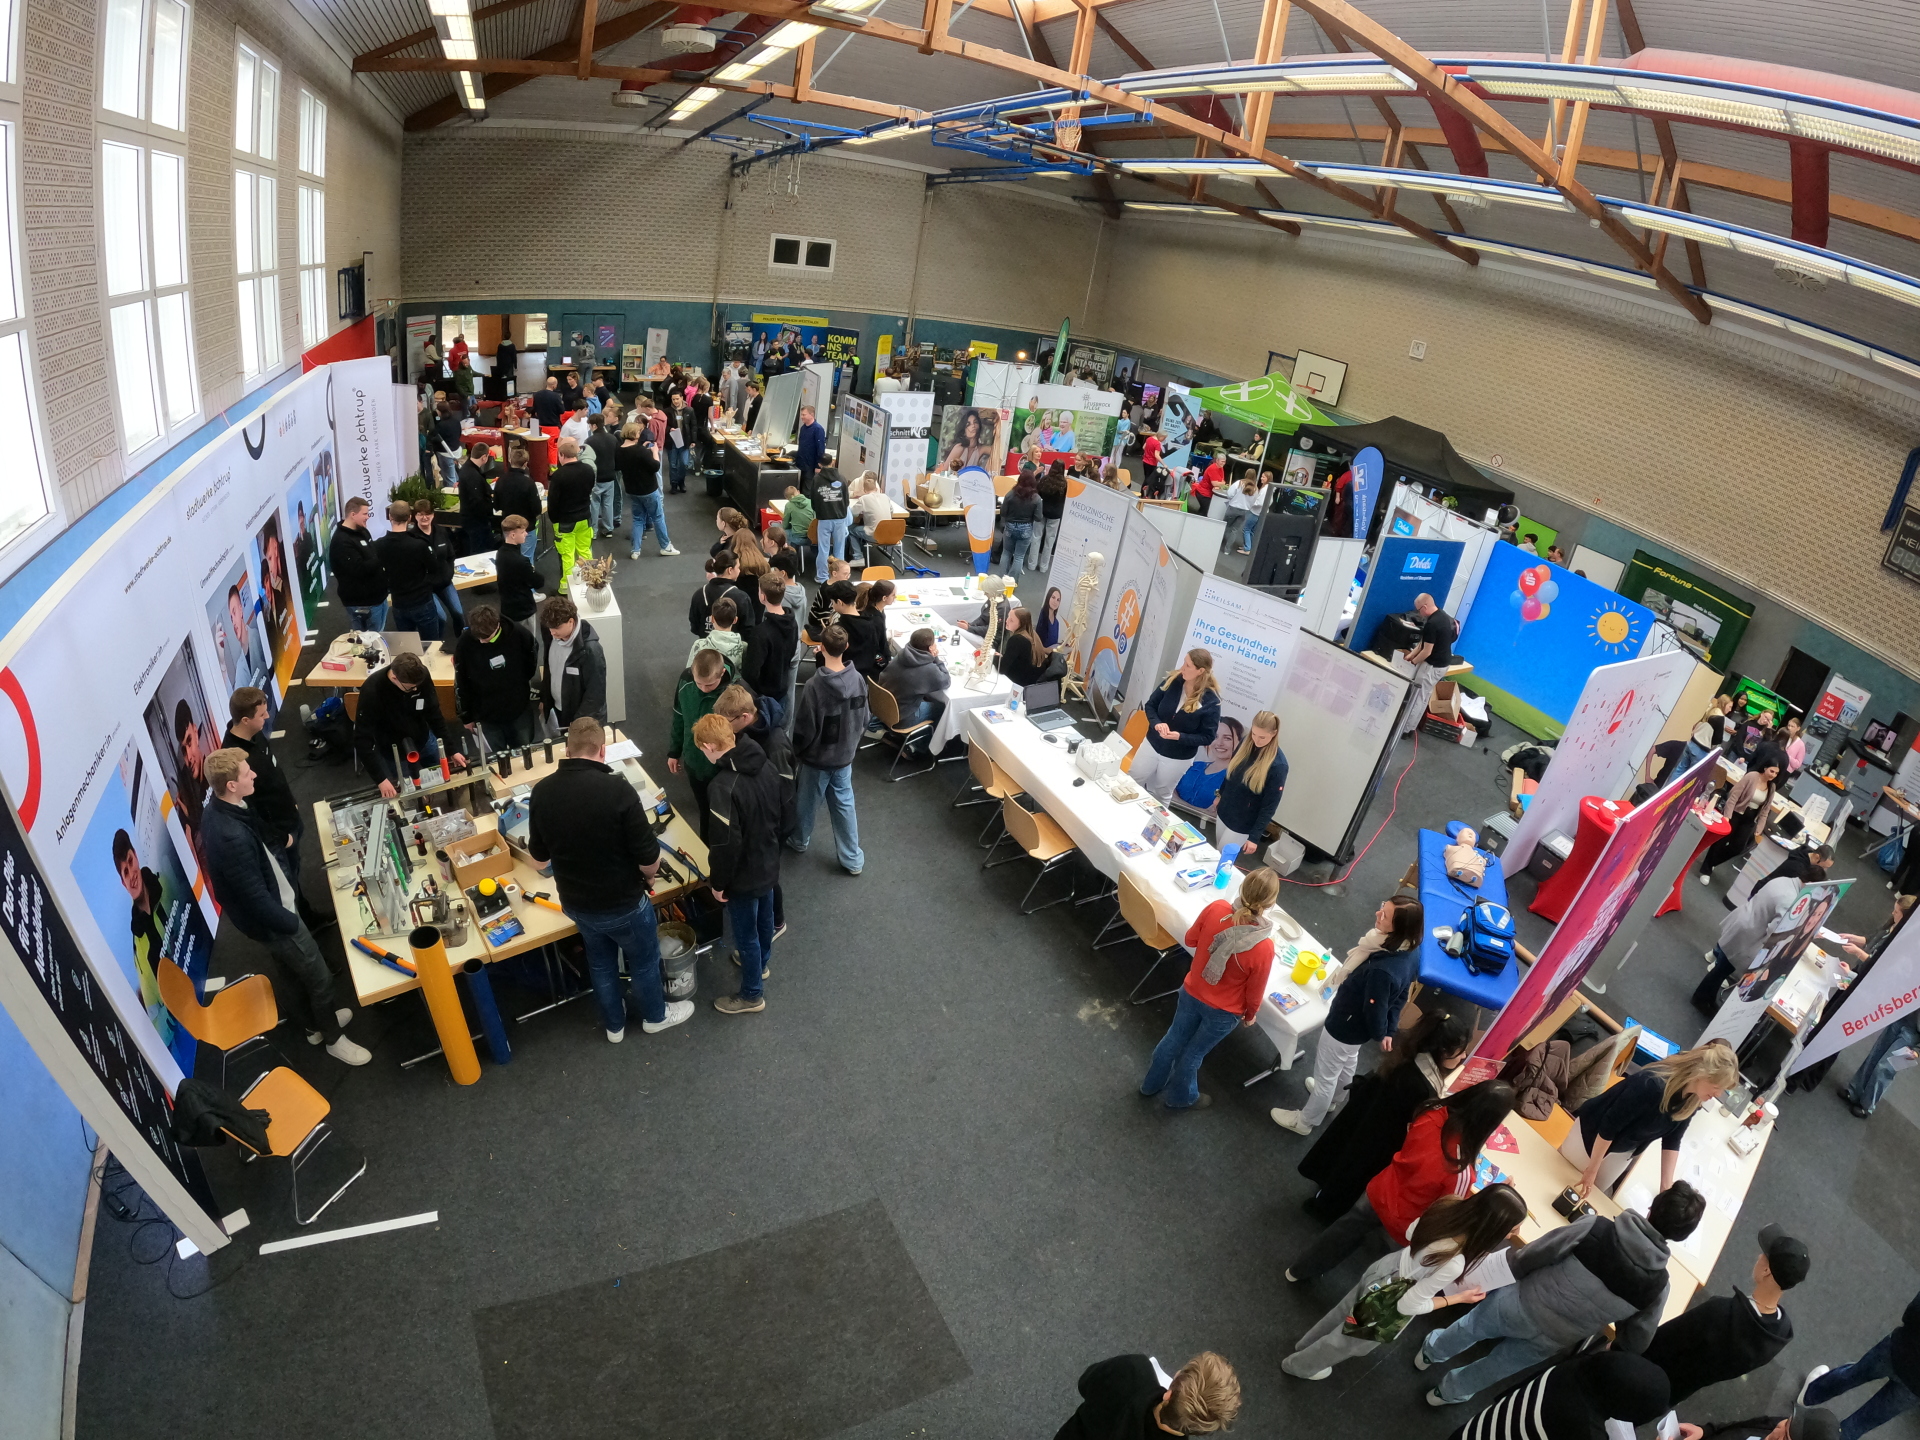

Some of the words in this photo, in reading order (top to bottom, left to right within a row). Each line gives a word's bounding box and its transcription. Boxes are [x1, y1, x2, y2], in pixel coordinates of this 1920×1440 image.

[827, 334, 857, 345] KOMM
[827, 343, 842, 351] INS
[827, 351, 850, 361] TEAM
[1068, 509, 1113, 533] FACHANGESTELLTE
[1070, 500, 1115, 524] MEDIZINISCHE
[1899, 534, 1920, 551] HEI
[1192, 628, 1202, 640] in
[1204, 635, 1235, 652] guten
[1237, 645, 1277, 668] Händen
[1195, 618, 1216, 632] Ihre
[1217, 626, 1277, 656] Gesundheit
[55, 733, 112, 846] Anlagenmechaniker:in
[4, 850, 15, 891] Plus
[3, 884, 15, 928] Das
[18, 874, 29, 924] deine
[18, 919, 30, 955] für
[31, 873, 46, 983] Ausbildung!
[1842, 986, 1920, 1037] Berufsber
